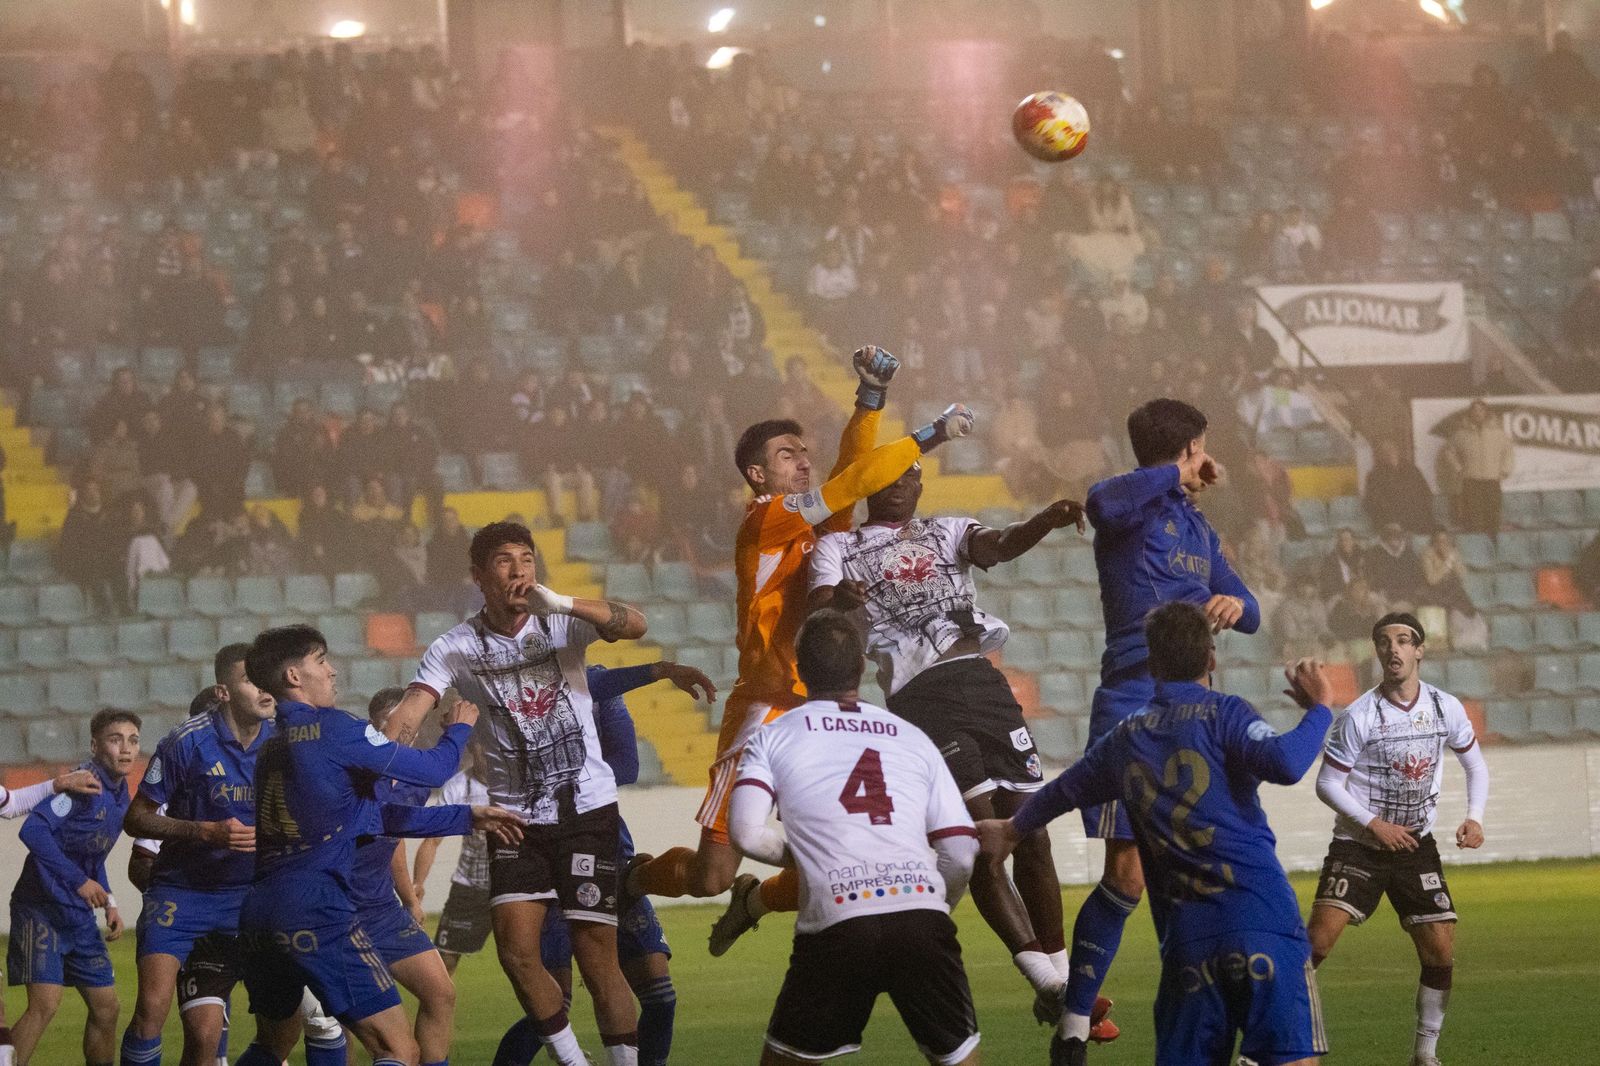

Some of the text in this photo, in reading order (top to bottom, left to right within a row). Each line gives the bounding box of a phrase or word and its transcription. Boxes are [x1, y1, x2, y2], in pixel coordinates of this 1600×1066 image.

[1303, 298, 1420, 329] ALJOMAR
[1503, 412, 1600, 448] JOMAR
[804, 715, 897, 737] I. CASADO
[838, 747, 894, 825] 4
[827, 860, 869, 881] nani
[1322, 876, 1349, 898] 20
